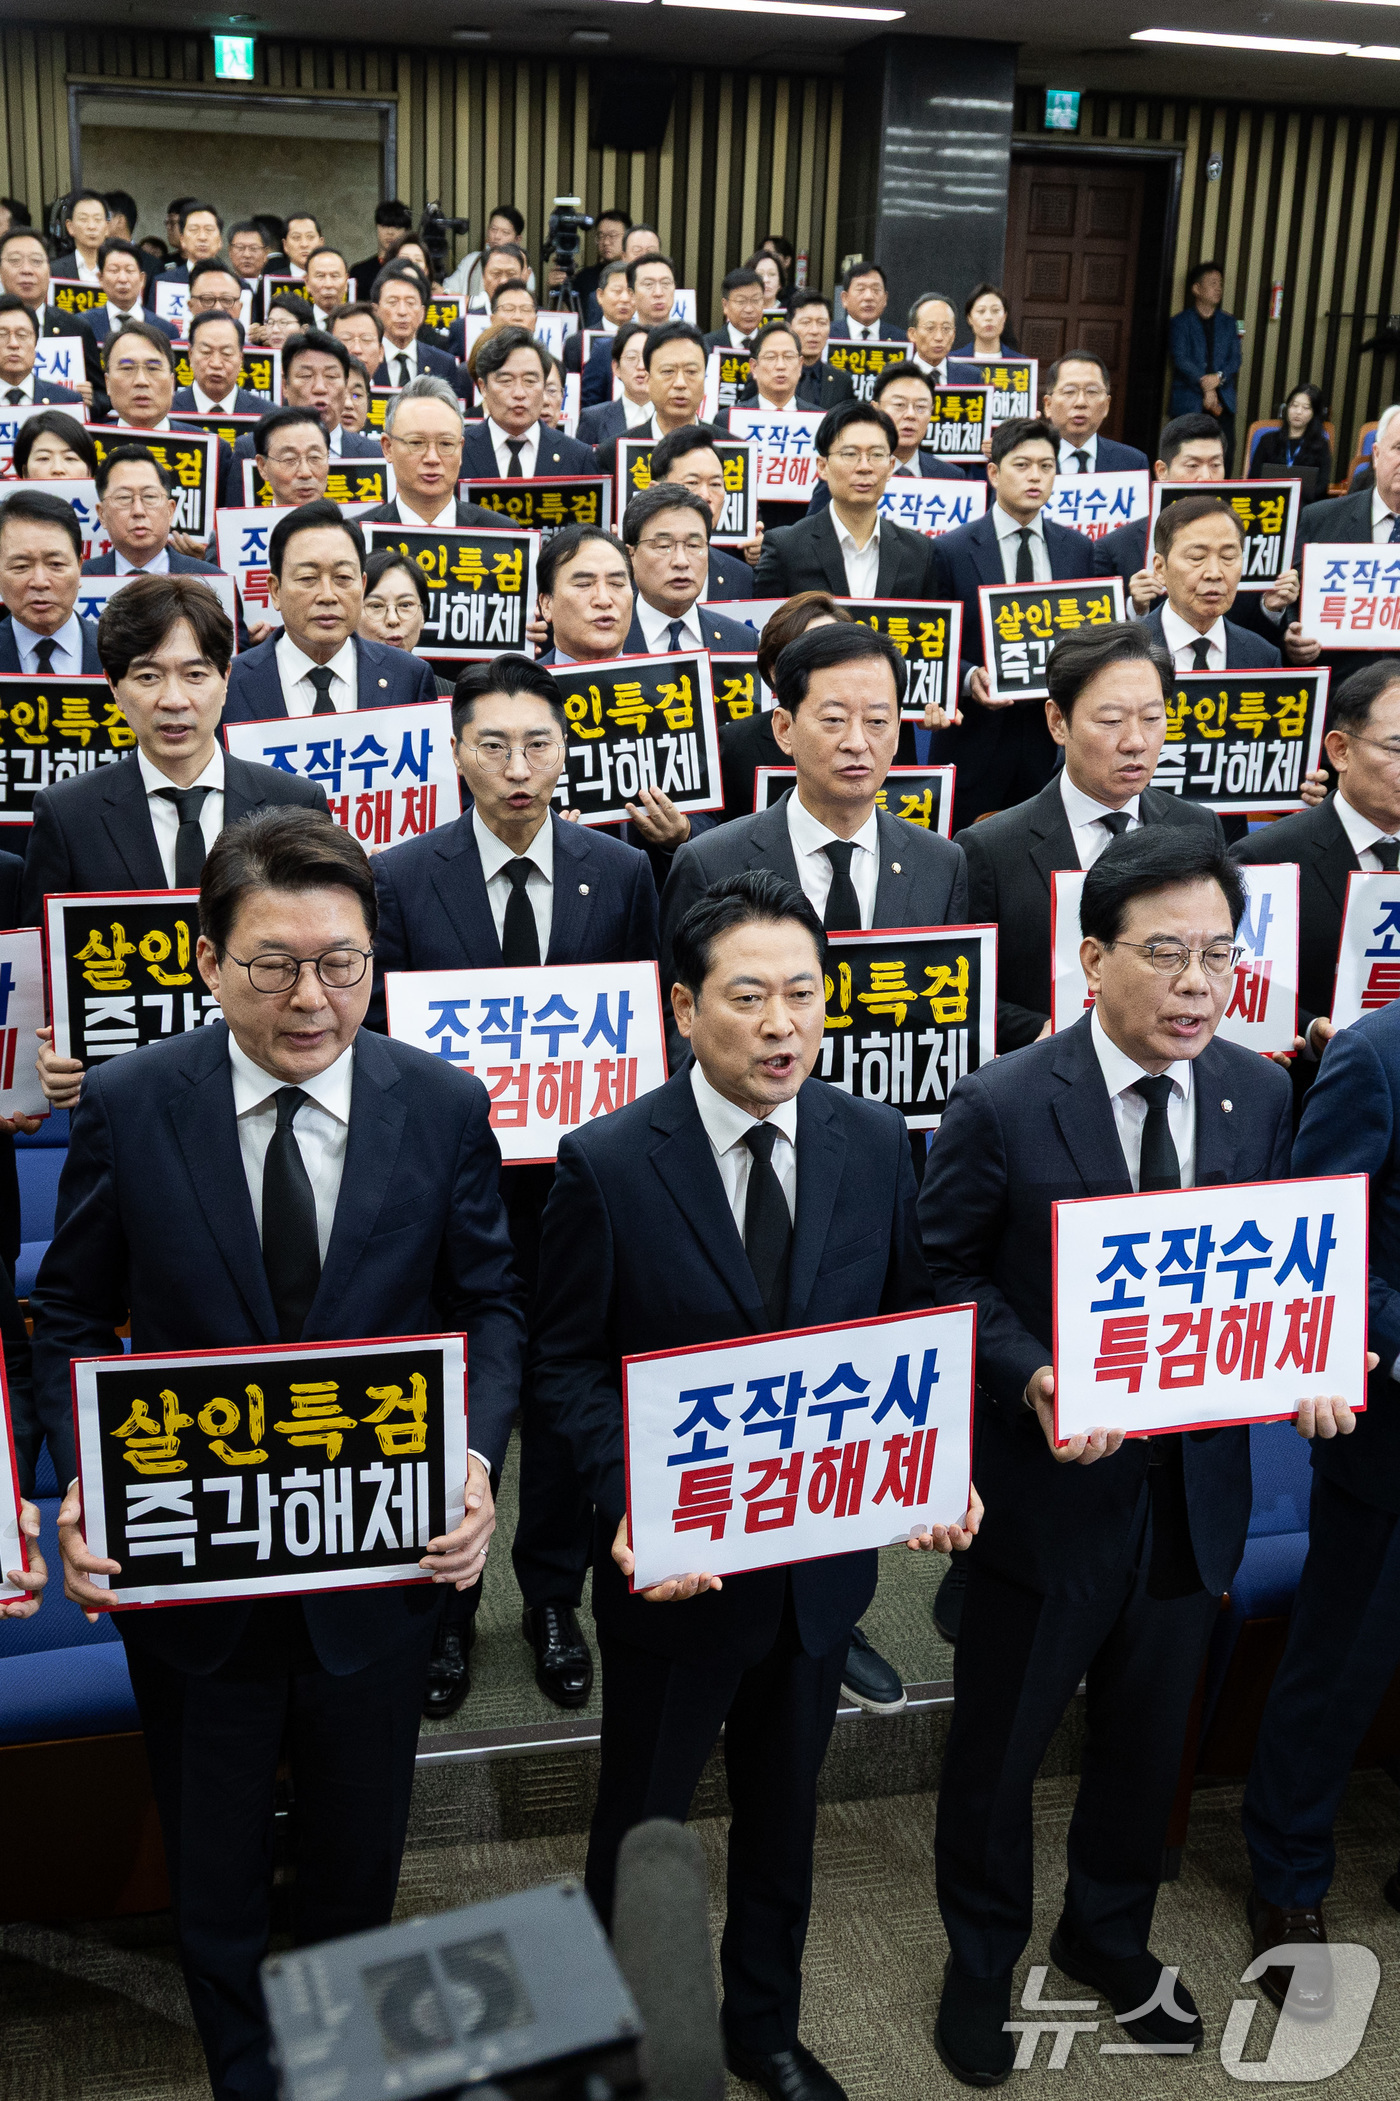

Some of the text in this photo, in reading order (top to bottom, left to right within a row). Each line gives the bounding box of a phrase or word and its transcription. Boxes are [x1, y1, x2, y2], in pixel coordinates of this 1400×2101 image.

[1150, 740, 1304, 795] 즉각해체
[425, 990, 634, 1061] 조작수사
[1090, 1213, 1338, 1313] 조작수사
[1093, 1295, 1336, 1394] 특검해체
[109, 1371, 428, 1475] 살인특검
[667, 1347, 941, 1468] 조작수사
[124, 1462, 430, 1567] 즉각해체
[671, 1427, 939, 1542] 특검해체
